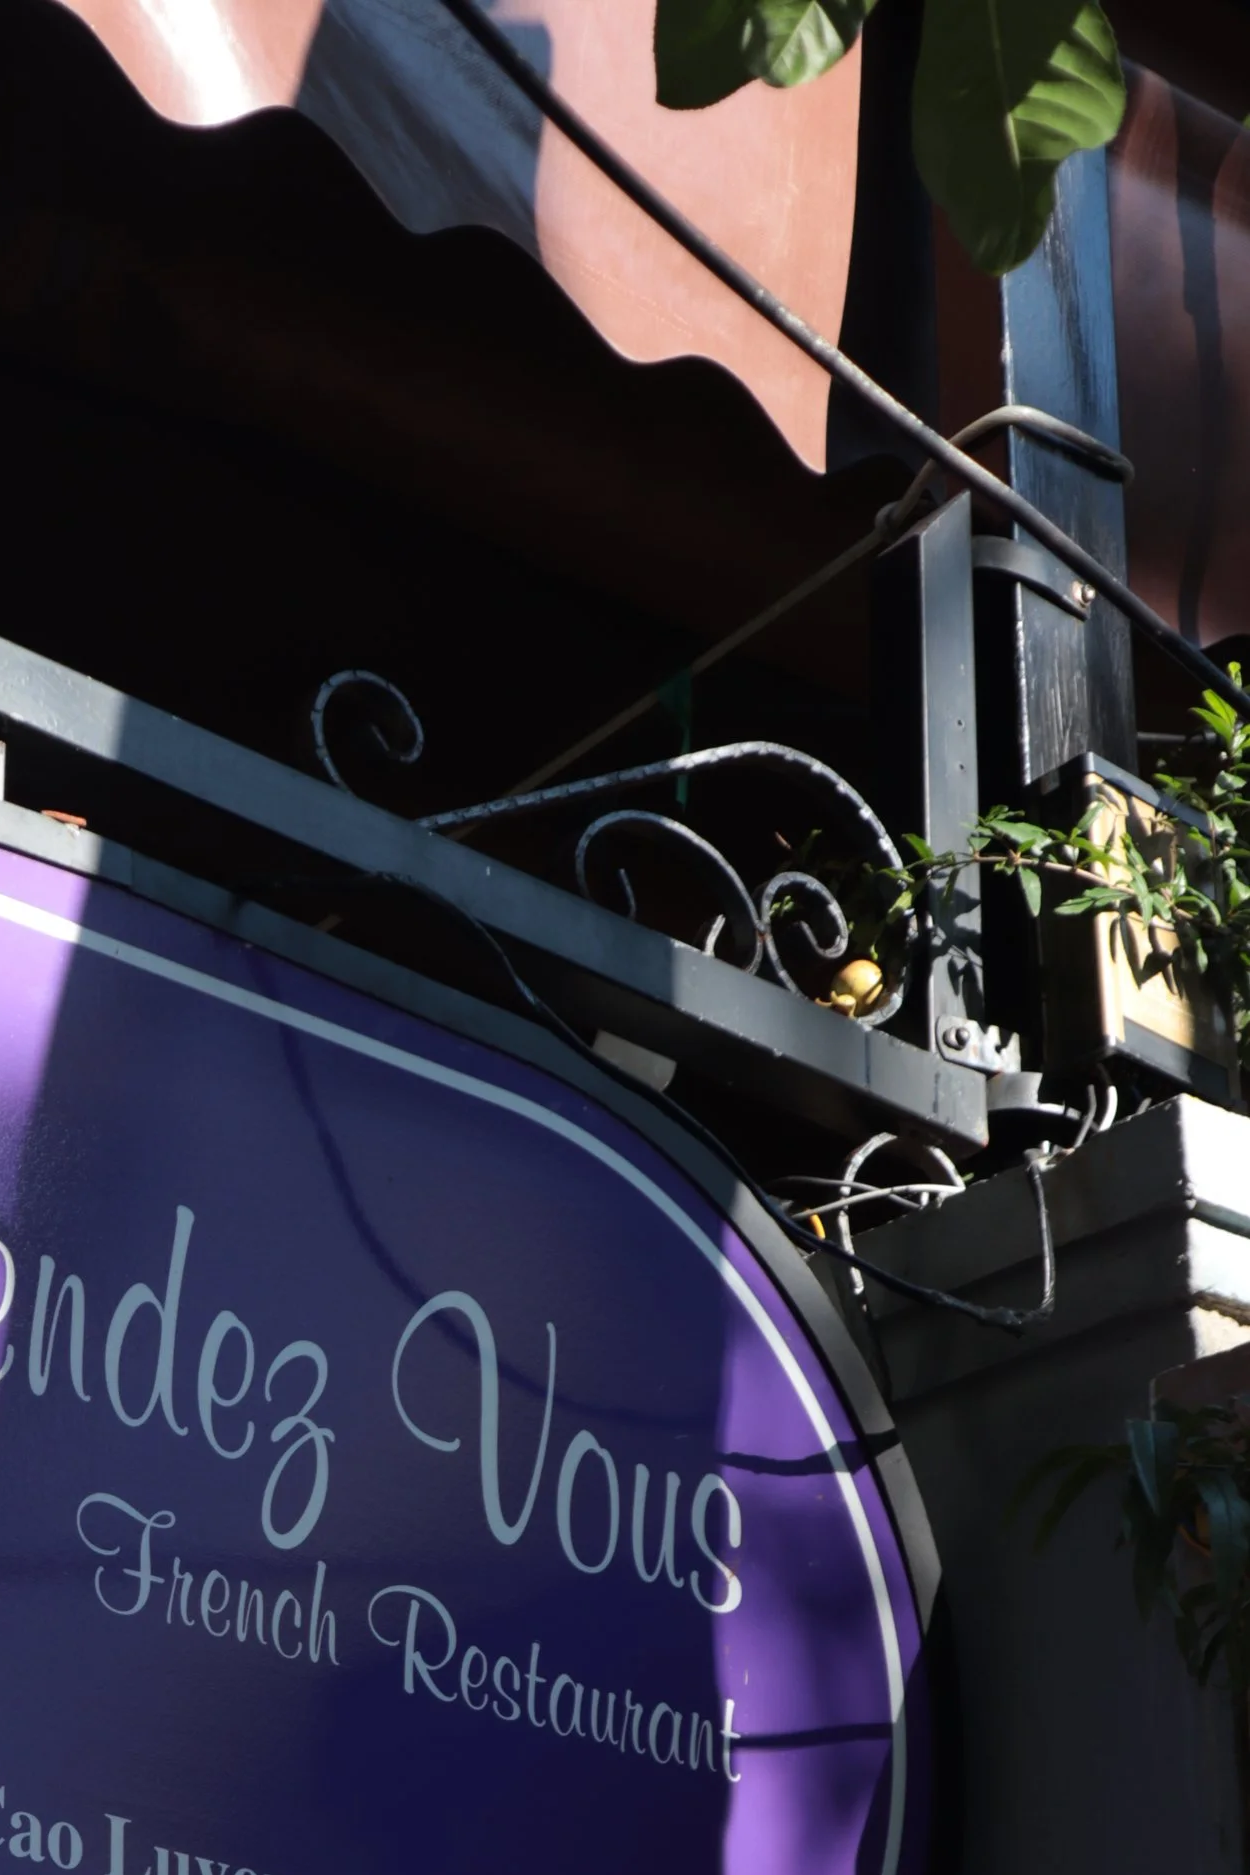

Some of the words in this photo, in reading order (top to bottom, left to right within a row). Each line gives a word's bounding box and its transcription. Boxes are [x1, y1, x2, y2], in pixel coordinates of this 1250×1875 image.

[392, 1290, 741, 1613] Vous
[76, 1492, 340, 1665] French
[368, 1584, 741, 1782] Restaurant
